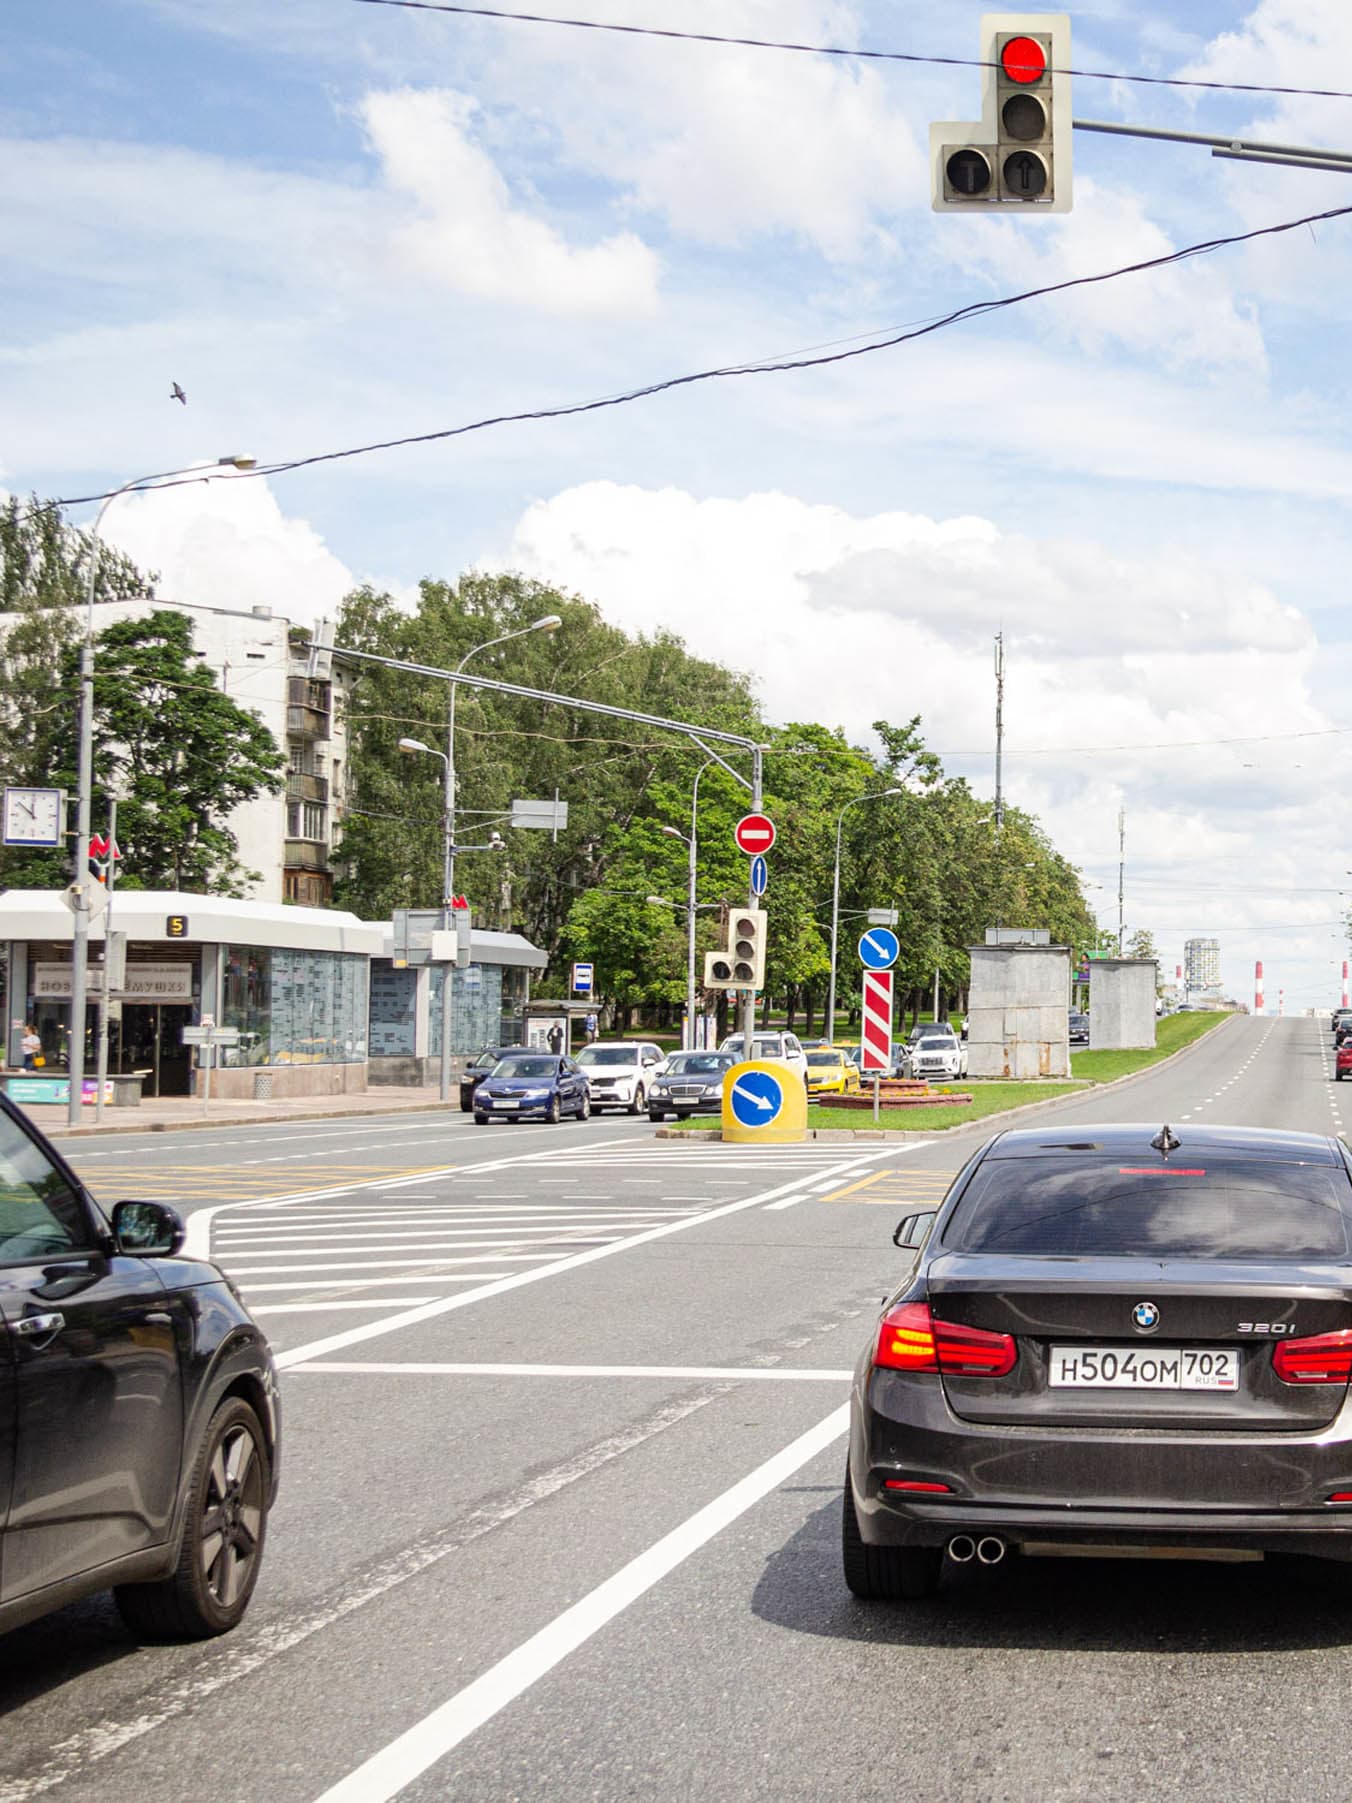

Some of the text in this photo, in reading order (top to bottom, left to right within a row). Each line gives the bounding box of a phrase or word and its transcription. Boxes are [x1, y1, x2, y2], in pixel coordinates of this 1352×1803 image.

[171, 918, 183, 931] 5
[1184, 1354, 1229, 1376] 702
[1195, 1377, 1217, 1385] RUS
